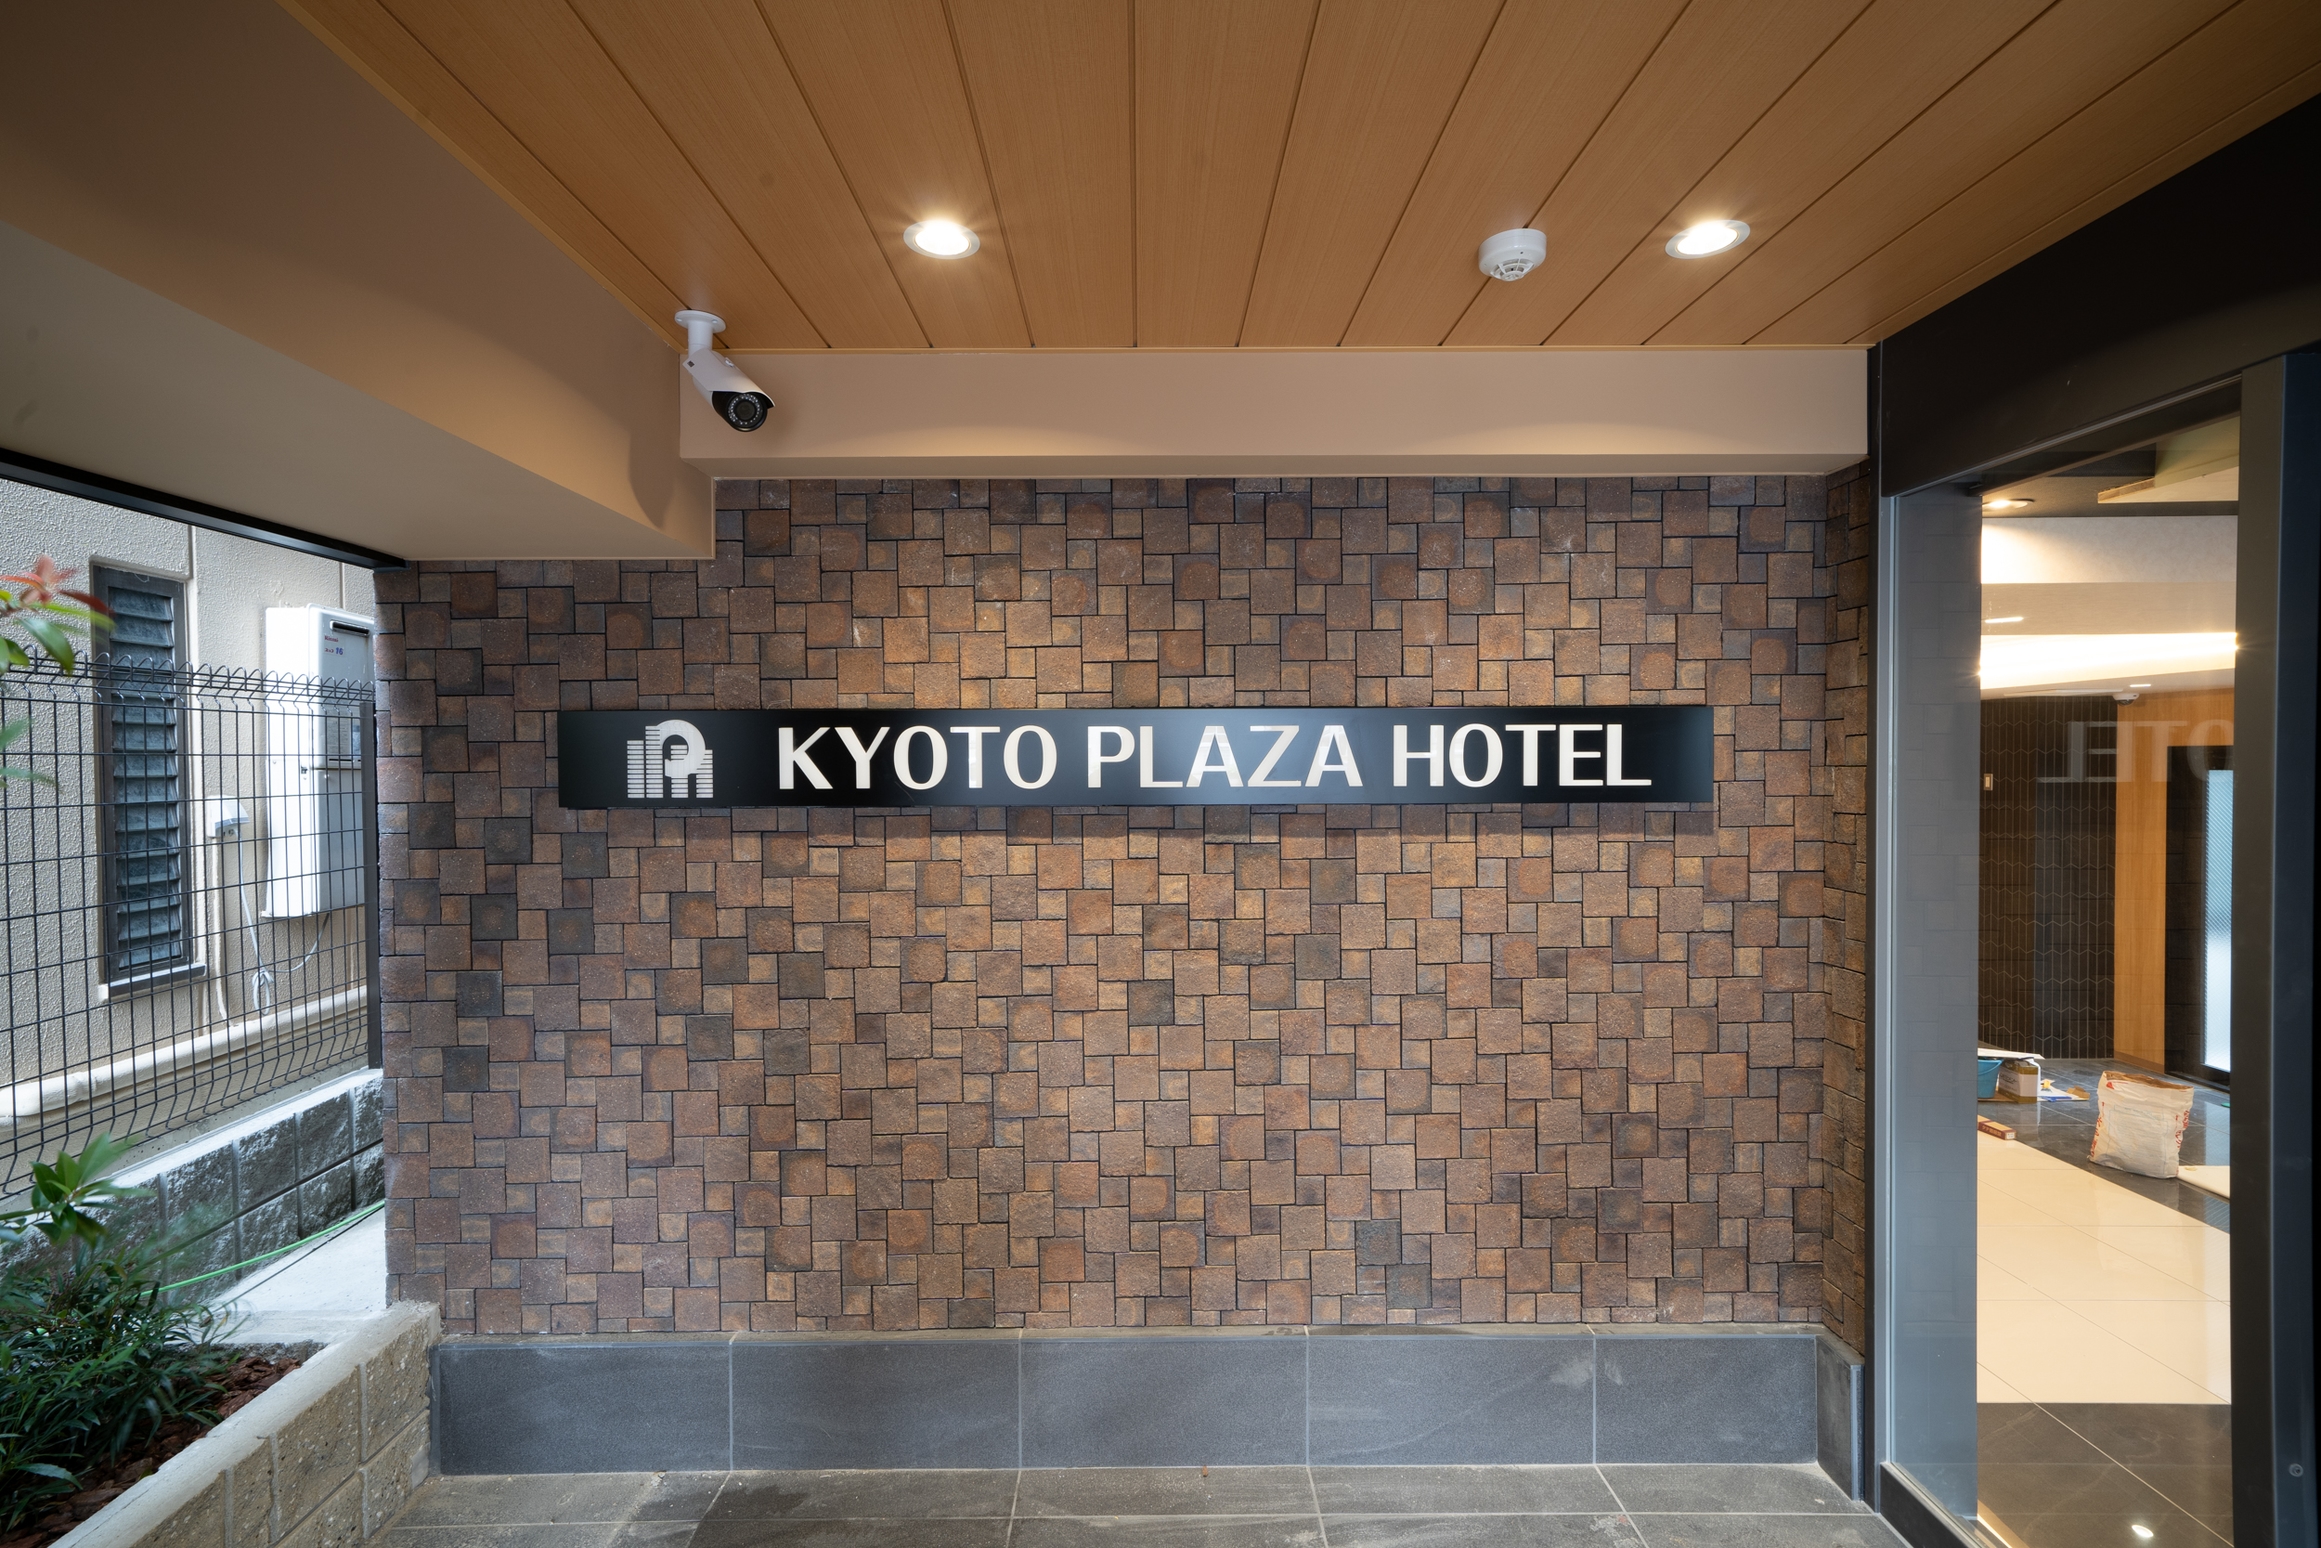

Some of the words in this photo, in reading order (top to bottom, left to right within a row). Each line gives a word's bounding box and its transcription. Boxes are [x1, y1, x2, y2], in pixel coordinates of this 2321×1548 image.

[778, 725, 1058, 790] KYOTO
[1087, 724, 1364, 788] PLAZA
[1393, 723, 1652, 788] HOTEL
